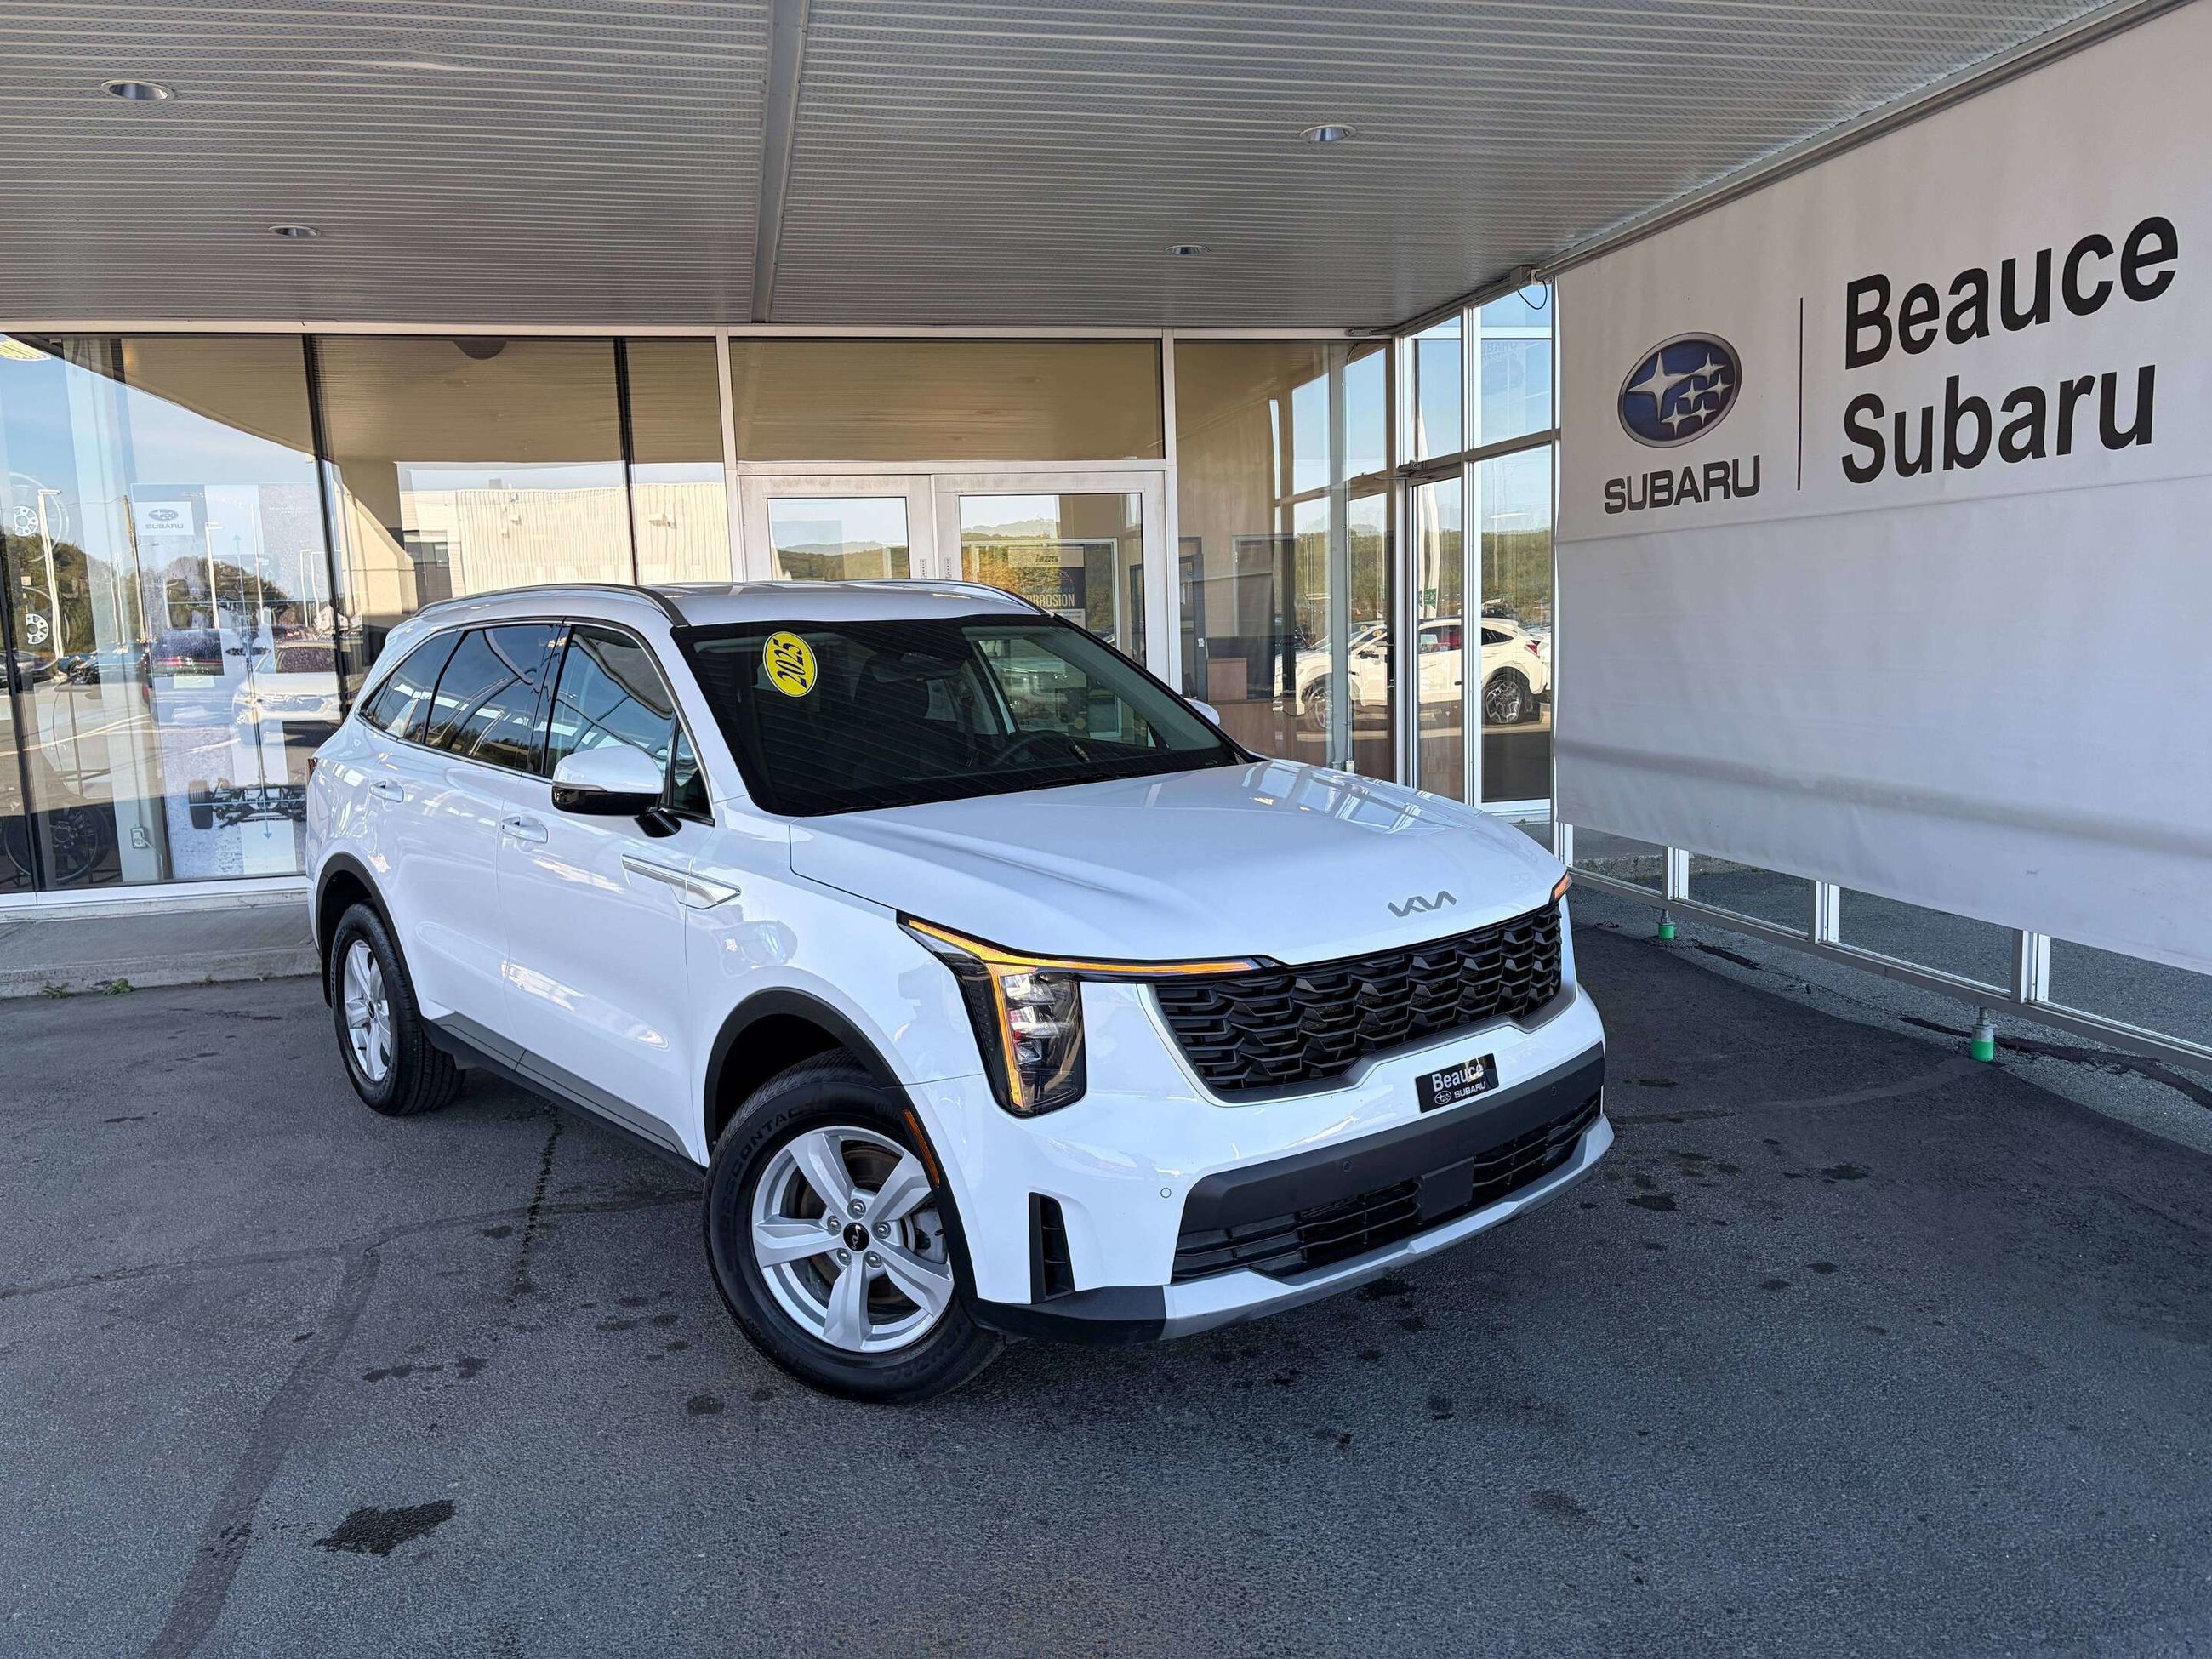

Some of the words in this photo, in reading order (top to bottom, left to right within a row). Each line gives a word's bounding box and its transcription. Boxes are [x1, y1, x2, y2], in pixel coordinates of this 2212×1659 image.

[1844, 216, 2179, 370] Beauce
[1841, 364, 2156, 484] Subaru
[1605, 454, 1760, 514] SUBARU
[1023, 593, 1075, 607] ORROSION
[772, 638, 807, 689] 2025
[1387, 890, 1457, 917] KIA
[1431, 1063, 1484, 1092] Beauce
[1454, 1081, 1486, 1099] SUBARU
